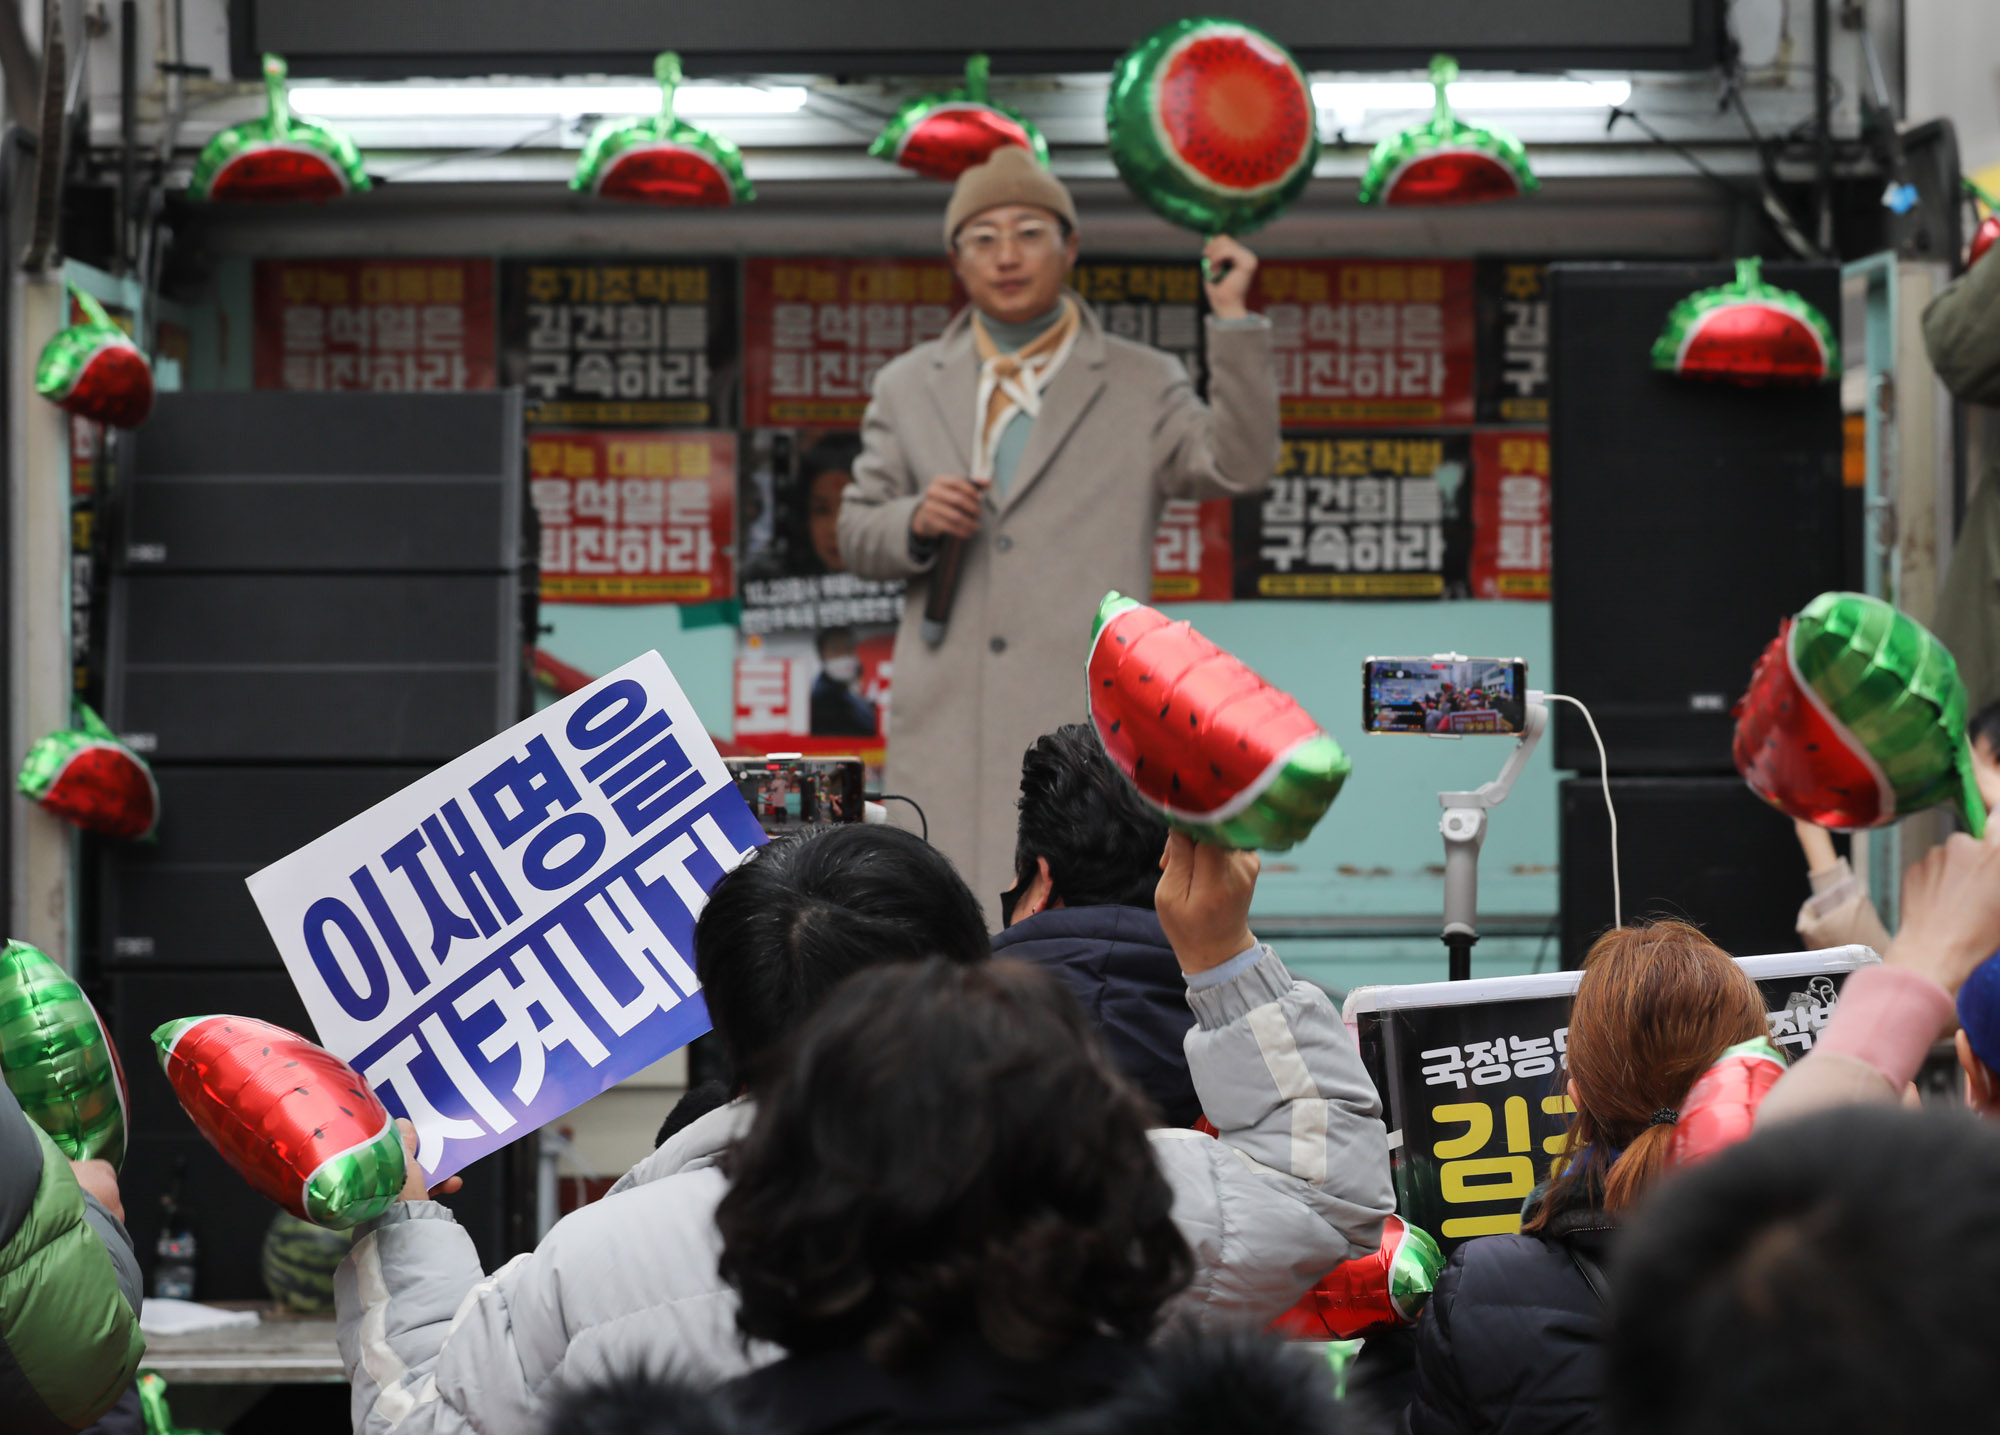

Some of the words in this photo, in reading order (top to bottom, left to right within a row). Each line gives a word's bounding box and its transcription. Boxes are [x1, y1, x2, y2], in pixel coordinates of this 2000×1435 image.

[527, 304, 707, 350] 김건희를
[527, 354, 712, 398] 구속하라
[1262, 477, 1443, 522] 김건희를
[1260, 525, 1446, 572] 구속하라
[303, 679, 707, 1022] 이재명을
